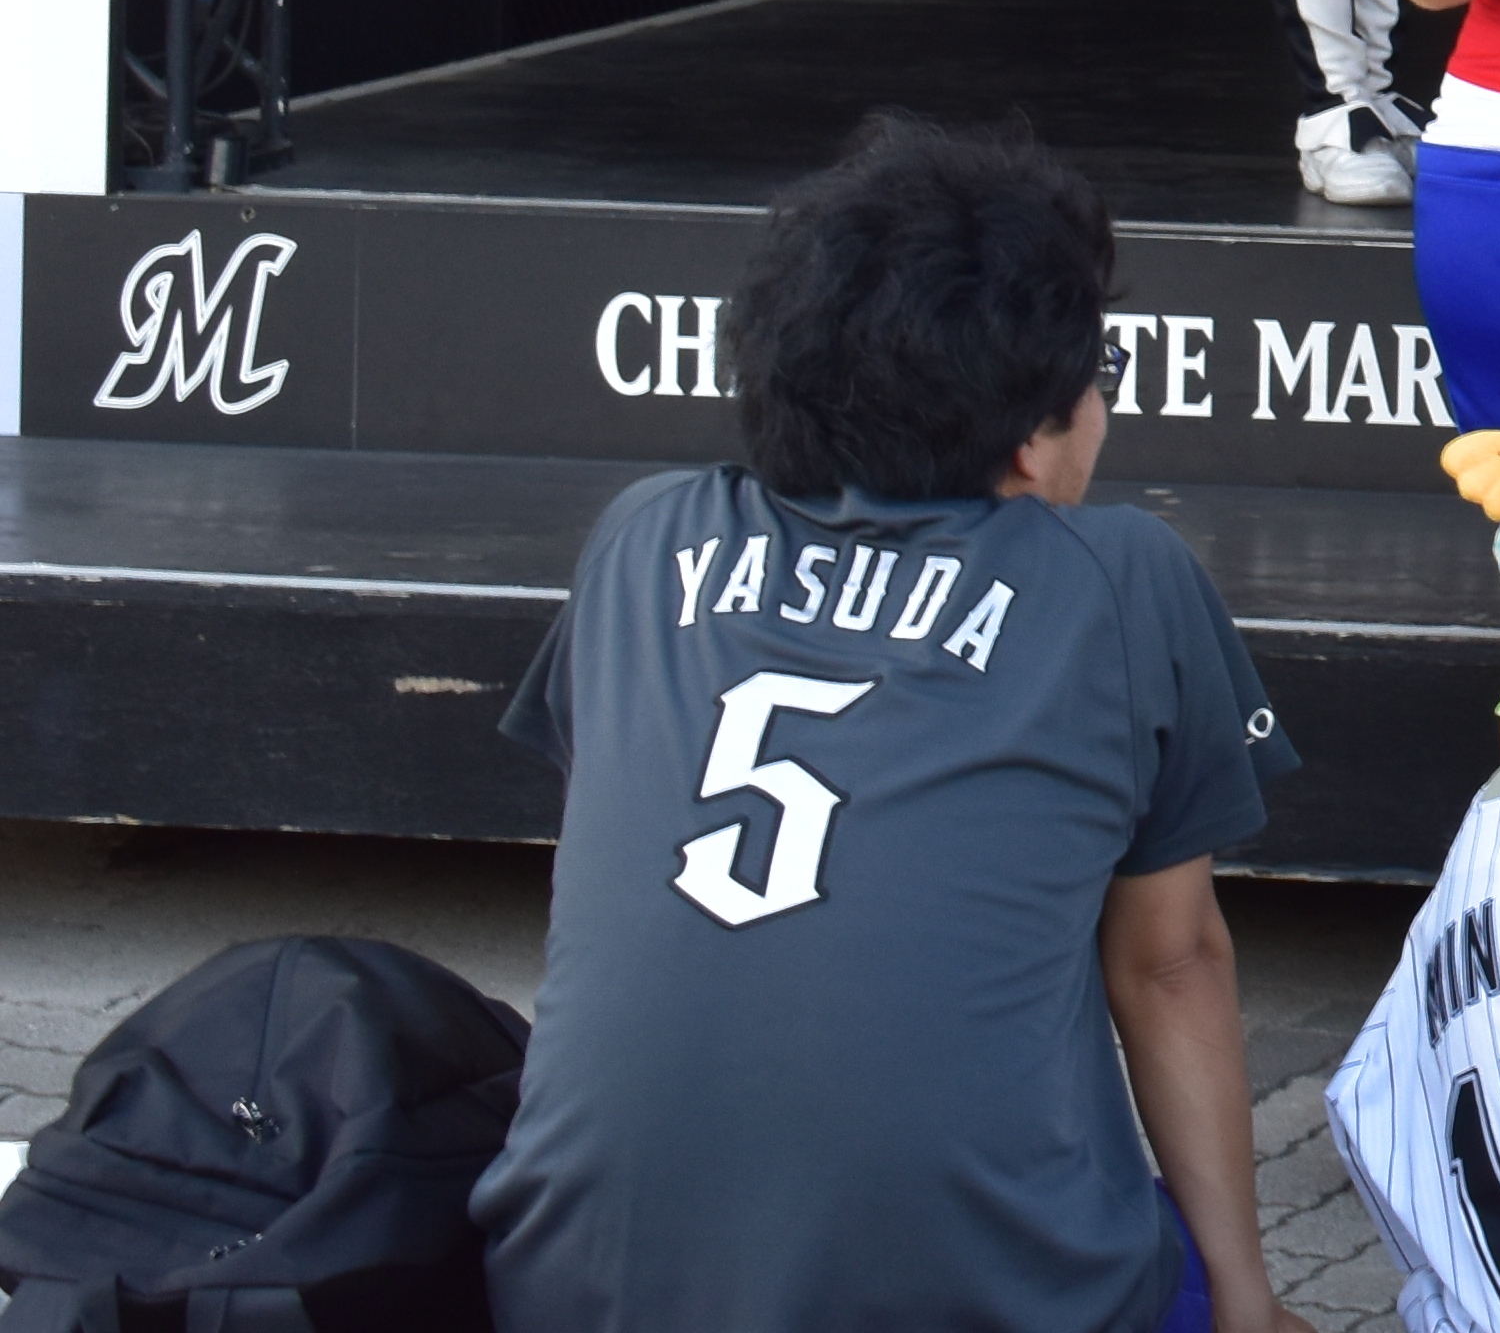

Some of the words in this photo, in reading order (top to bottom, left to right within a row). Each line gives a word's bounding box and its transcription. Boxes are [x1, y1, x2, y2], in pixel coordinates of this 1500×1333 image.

[93, 228, 299, 416] M
[673, 533, 1017, 674] YASUDA
[671, 669, 881, 929] 5
